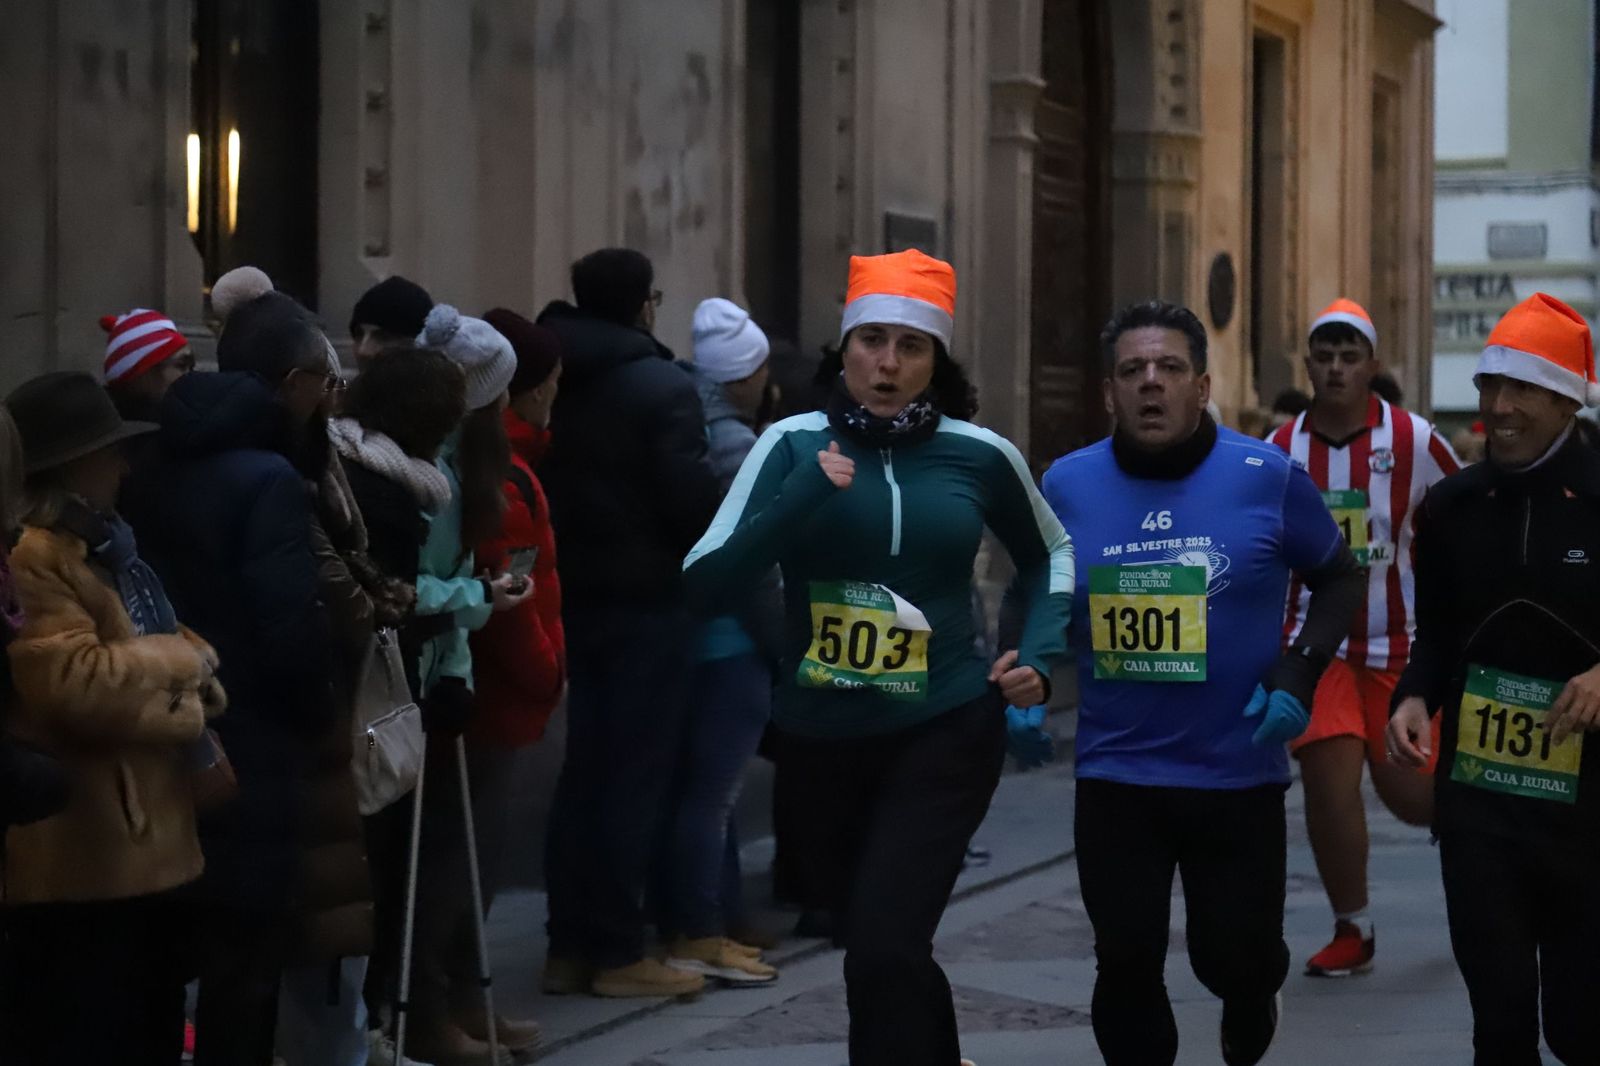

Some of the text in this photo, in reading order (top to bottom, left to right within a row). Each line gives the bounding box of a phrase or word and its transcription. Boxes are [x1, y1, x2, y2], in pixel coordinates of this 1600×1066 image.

[1141, 511, 1173, 531] 46
[1103, 537, 1212, 556] SAN SILVESTRE 2025
[1119, 579, 1171, 588] CAJA RURAL
[845, 589, 868, 601] CAJA
[1102, 606, 1181, 651] 1301
[818, 616, 912, 670] 503
[1123, 660, 1199, 673] CAJA RURAL
[874, 682, 920, 693] URAL
[1518, 690, 1550, 704] RURAL
[1476, 704, 1551, 761] 1131
[1484, 769, 1570, 793] CAJA RURAL
